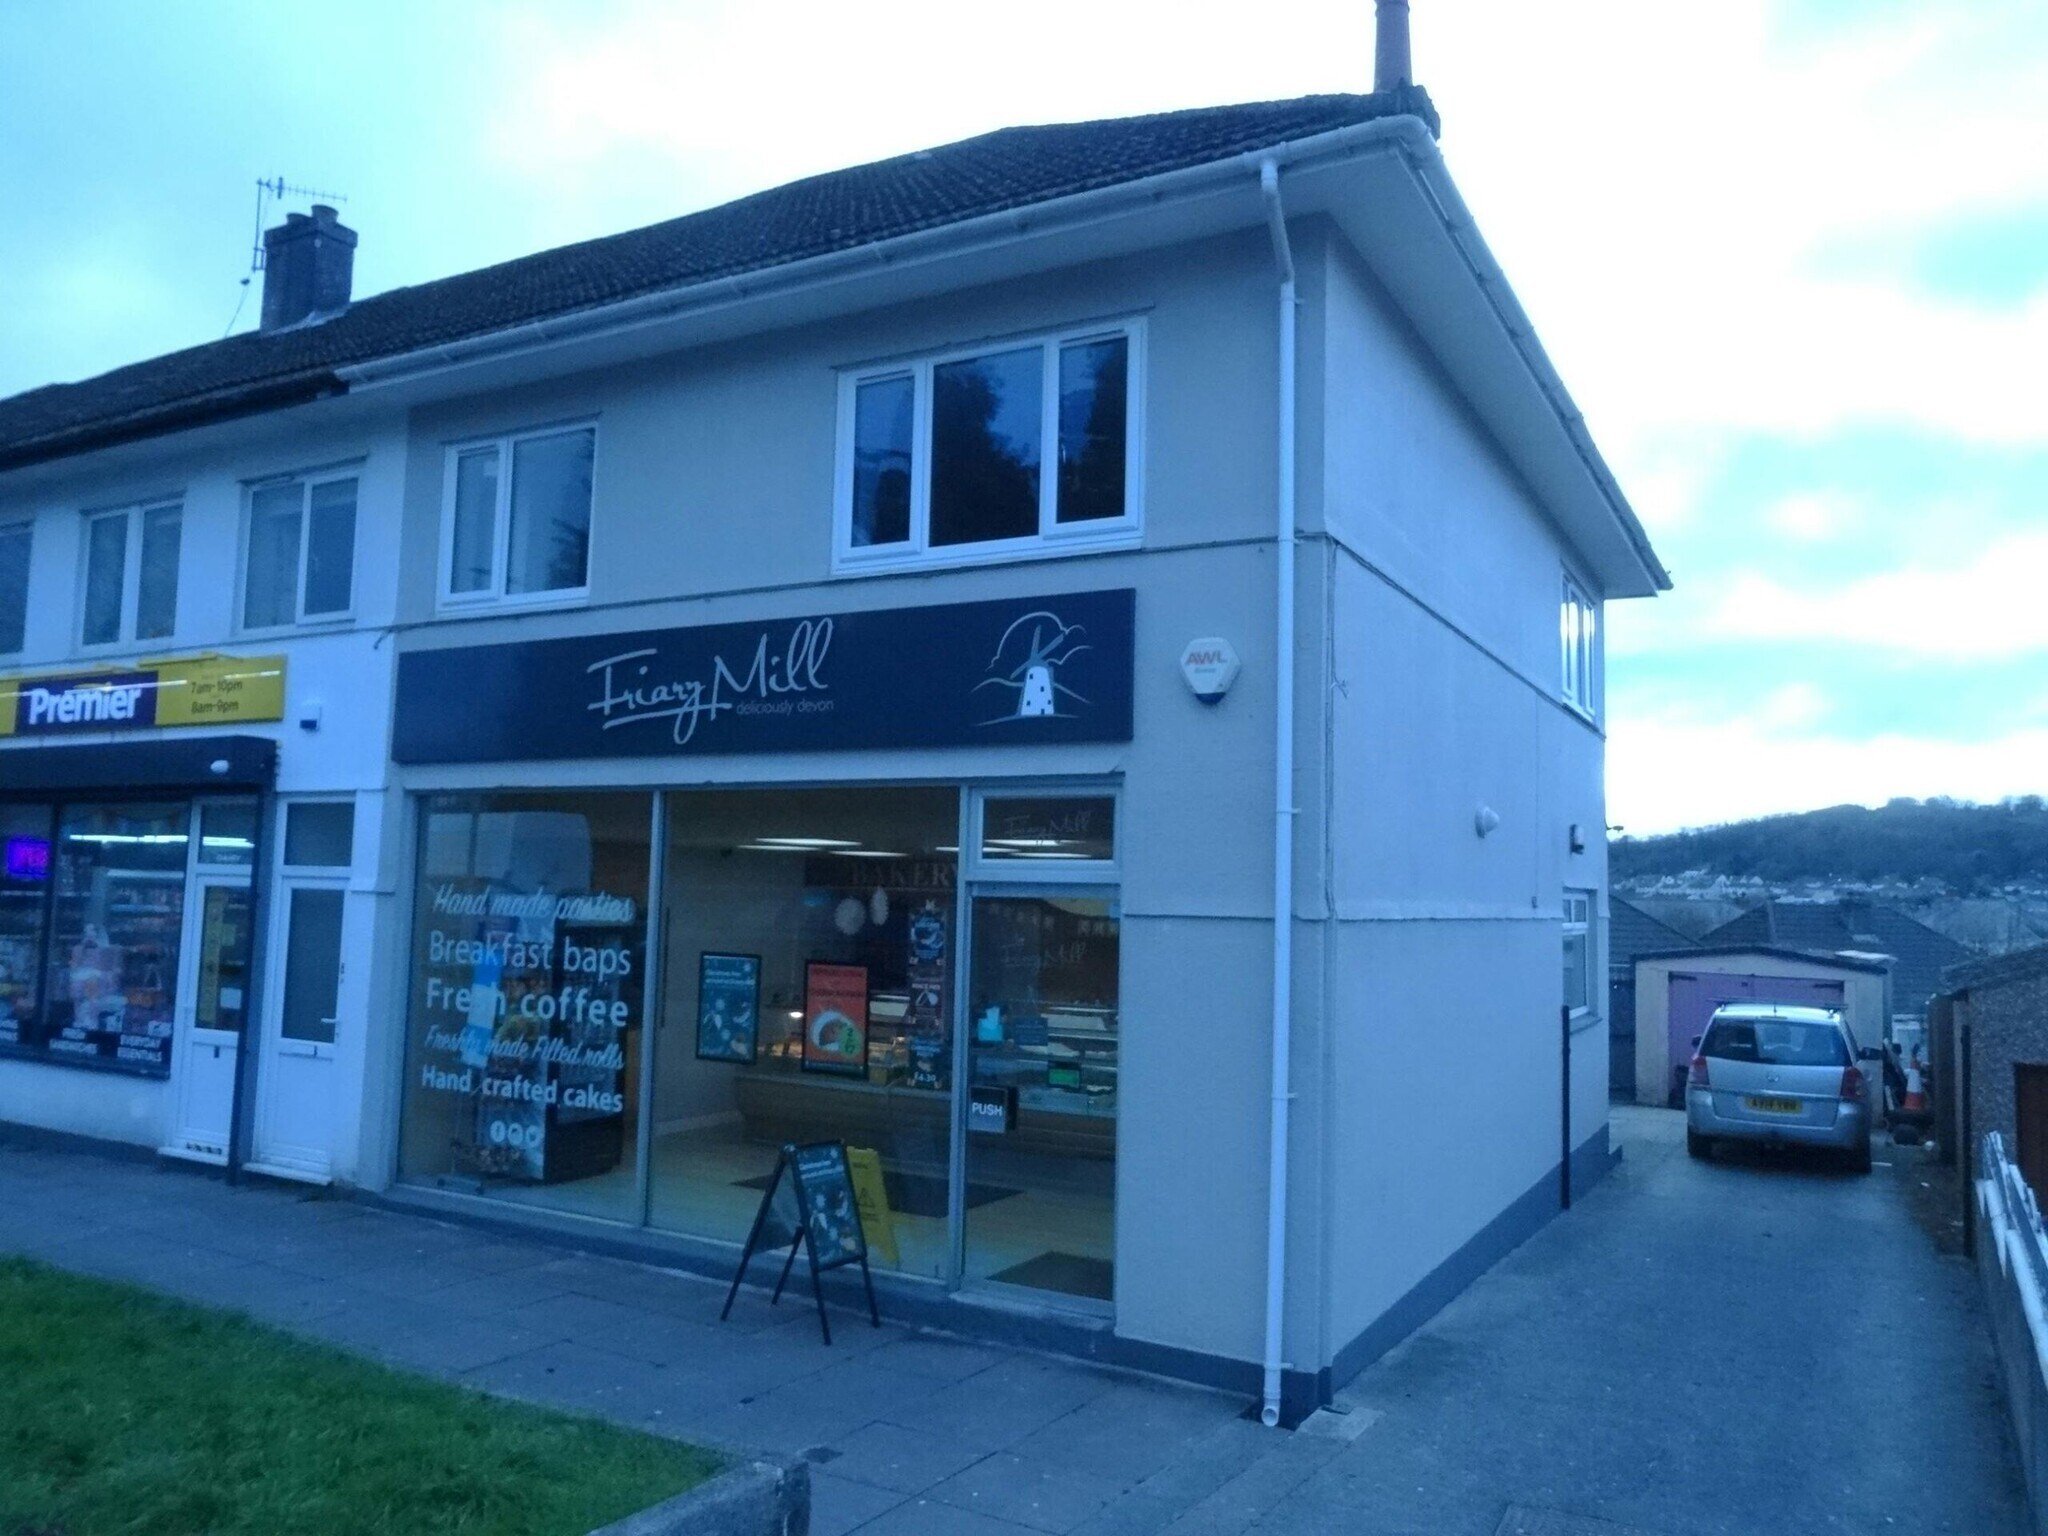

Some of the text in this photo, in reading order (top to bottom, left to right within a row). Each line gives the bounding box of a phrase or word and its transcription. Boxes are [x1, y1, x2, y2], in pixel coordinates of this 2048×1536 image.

[1185, 650, 1228, 666] AWL
[586, 617, 834, 744] Friary Mill
[28, 687, 142, 725] Premier
[736, 700, 793, 717] deliciously
[429, 930, 631, 981] Breakfast baps
[426, 977, 629, 1027] Freh coffee
[421, 1064, 625, 1113] Hand crafted cakes
[971, 1102, 1004, 1116] PUSH
